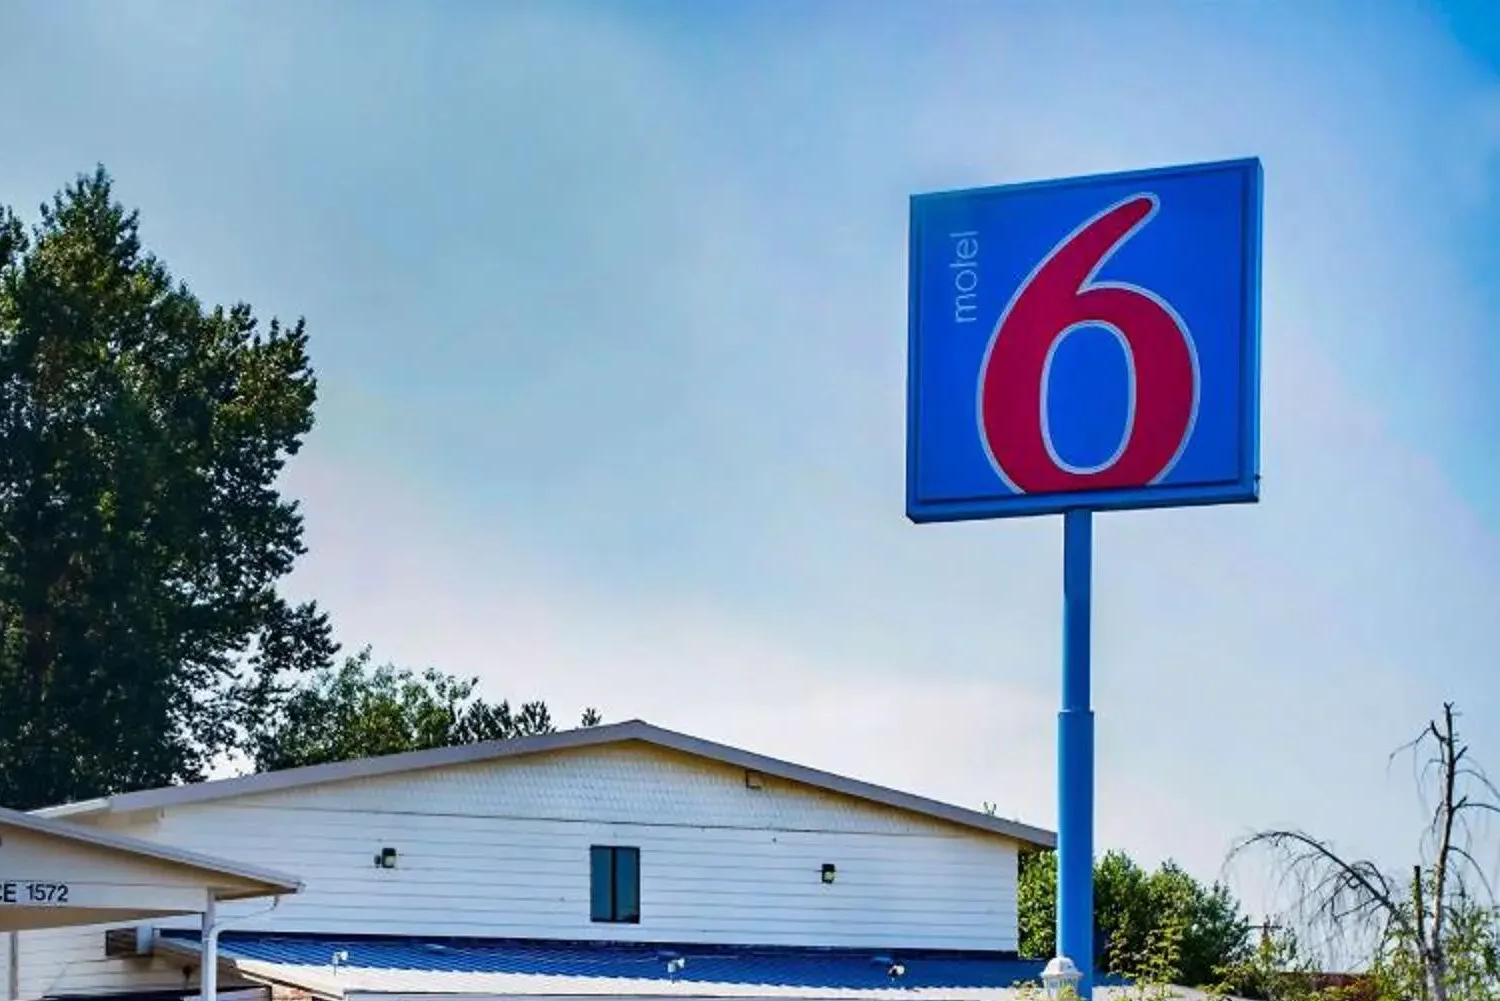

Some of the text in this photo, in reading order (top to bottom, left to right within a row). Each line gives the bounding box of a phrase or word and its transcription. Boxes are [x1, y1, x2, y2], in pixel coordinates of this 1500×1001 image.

[949, 230, 979, 323] motel
[977, 192, 1200, 494] 6
[26, 883, 69, 903] 1572
